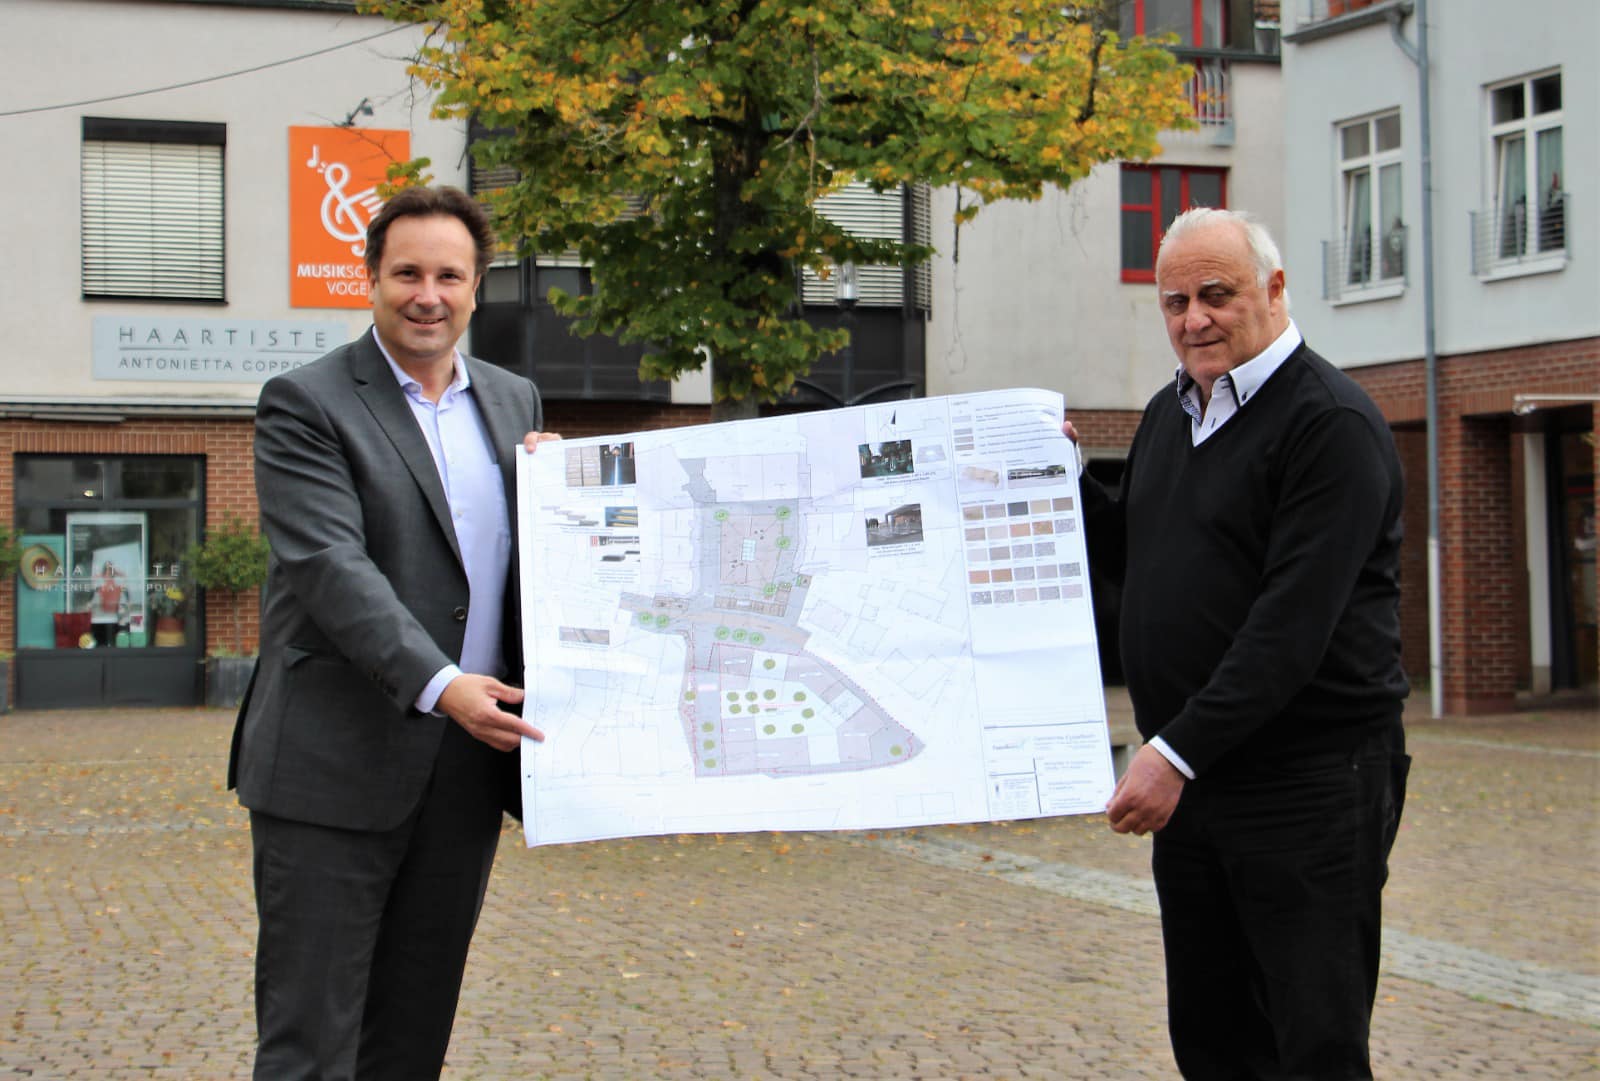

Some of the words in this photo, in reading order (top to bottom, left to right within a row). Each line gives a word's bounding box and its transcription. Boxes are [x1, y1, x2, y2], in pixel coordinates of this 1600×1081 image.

[297, 264, 368, 278] MUSIKSC
[119, 327, 325, 348] HAARTISTE
[119, 358, 233, 371] ANTONIETTA
